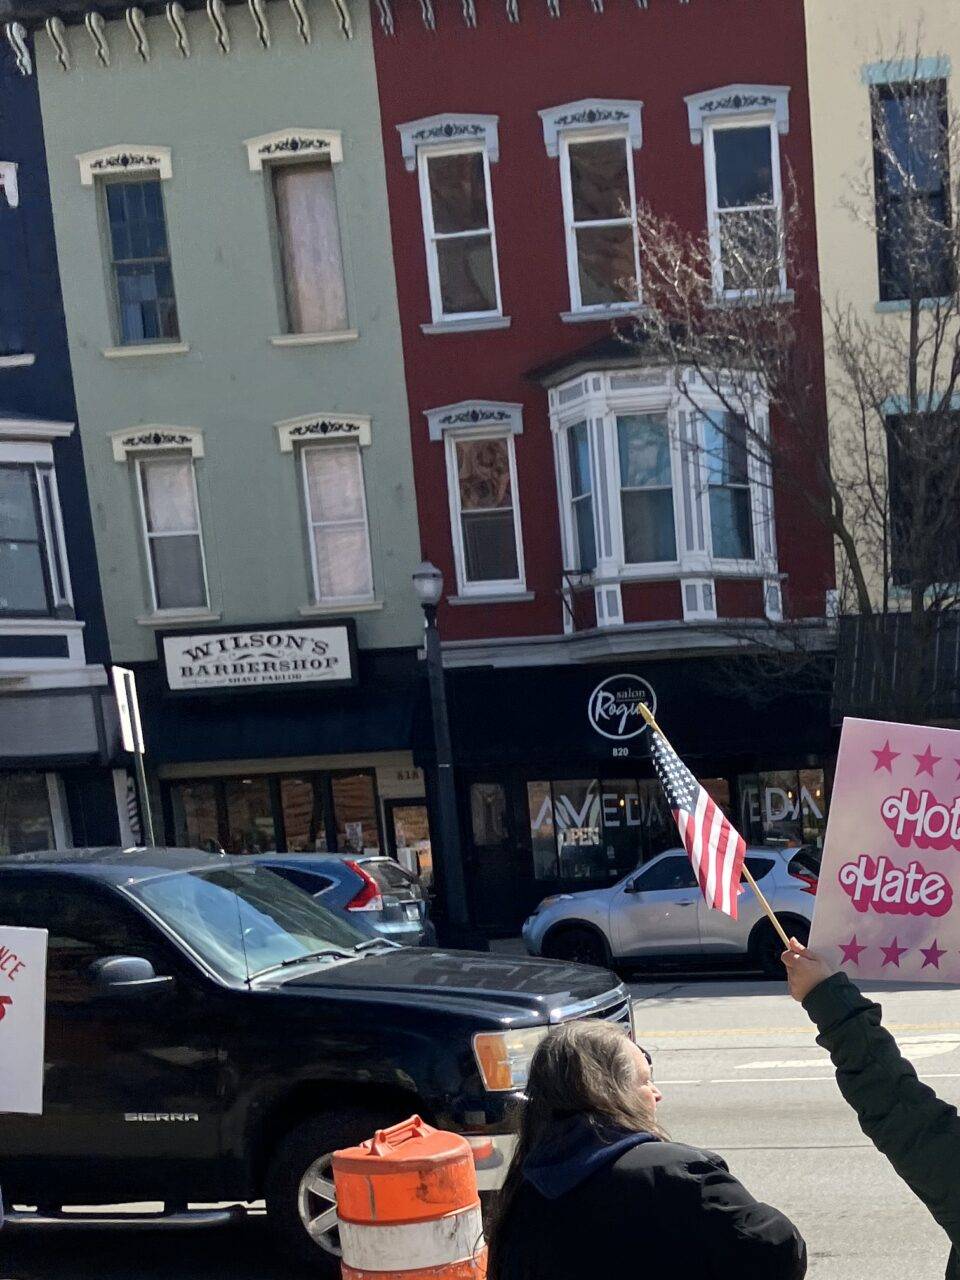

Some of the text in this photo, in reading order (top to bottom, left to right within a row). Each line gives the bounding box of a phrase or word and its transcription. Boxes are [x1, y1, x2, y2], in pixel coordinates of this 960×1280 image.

[182, 634, 329, 662] WILSON'S
[180, 656, 339, 679] BARBERSHOP
[616, 688, 646, 699] salon
[595, 690, 650, 735] Rogu
[612, 748, 629, 757] 820
[559, 826, 600, 846] OPEN
[839, 855, 952, 915] Hate
[124, 1113, 199, 1122] SIERRA
